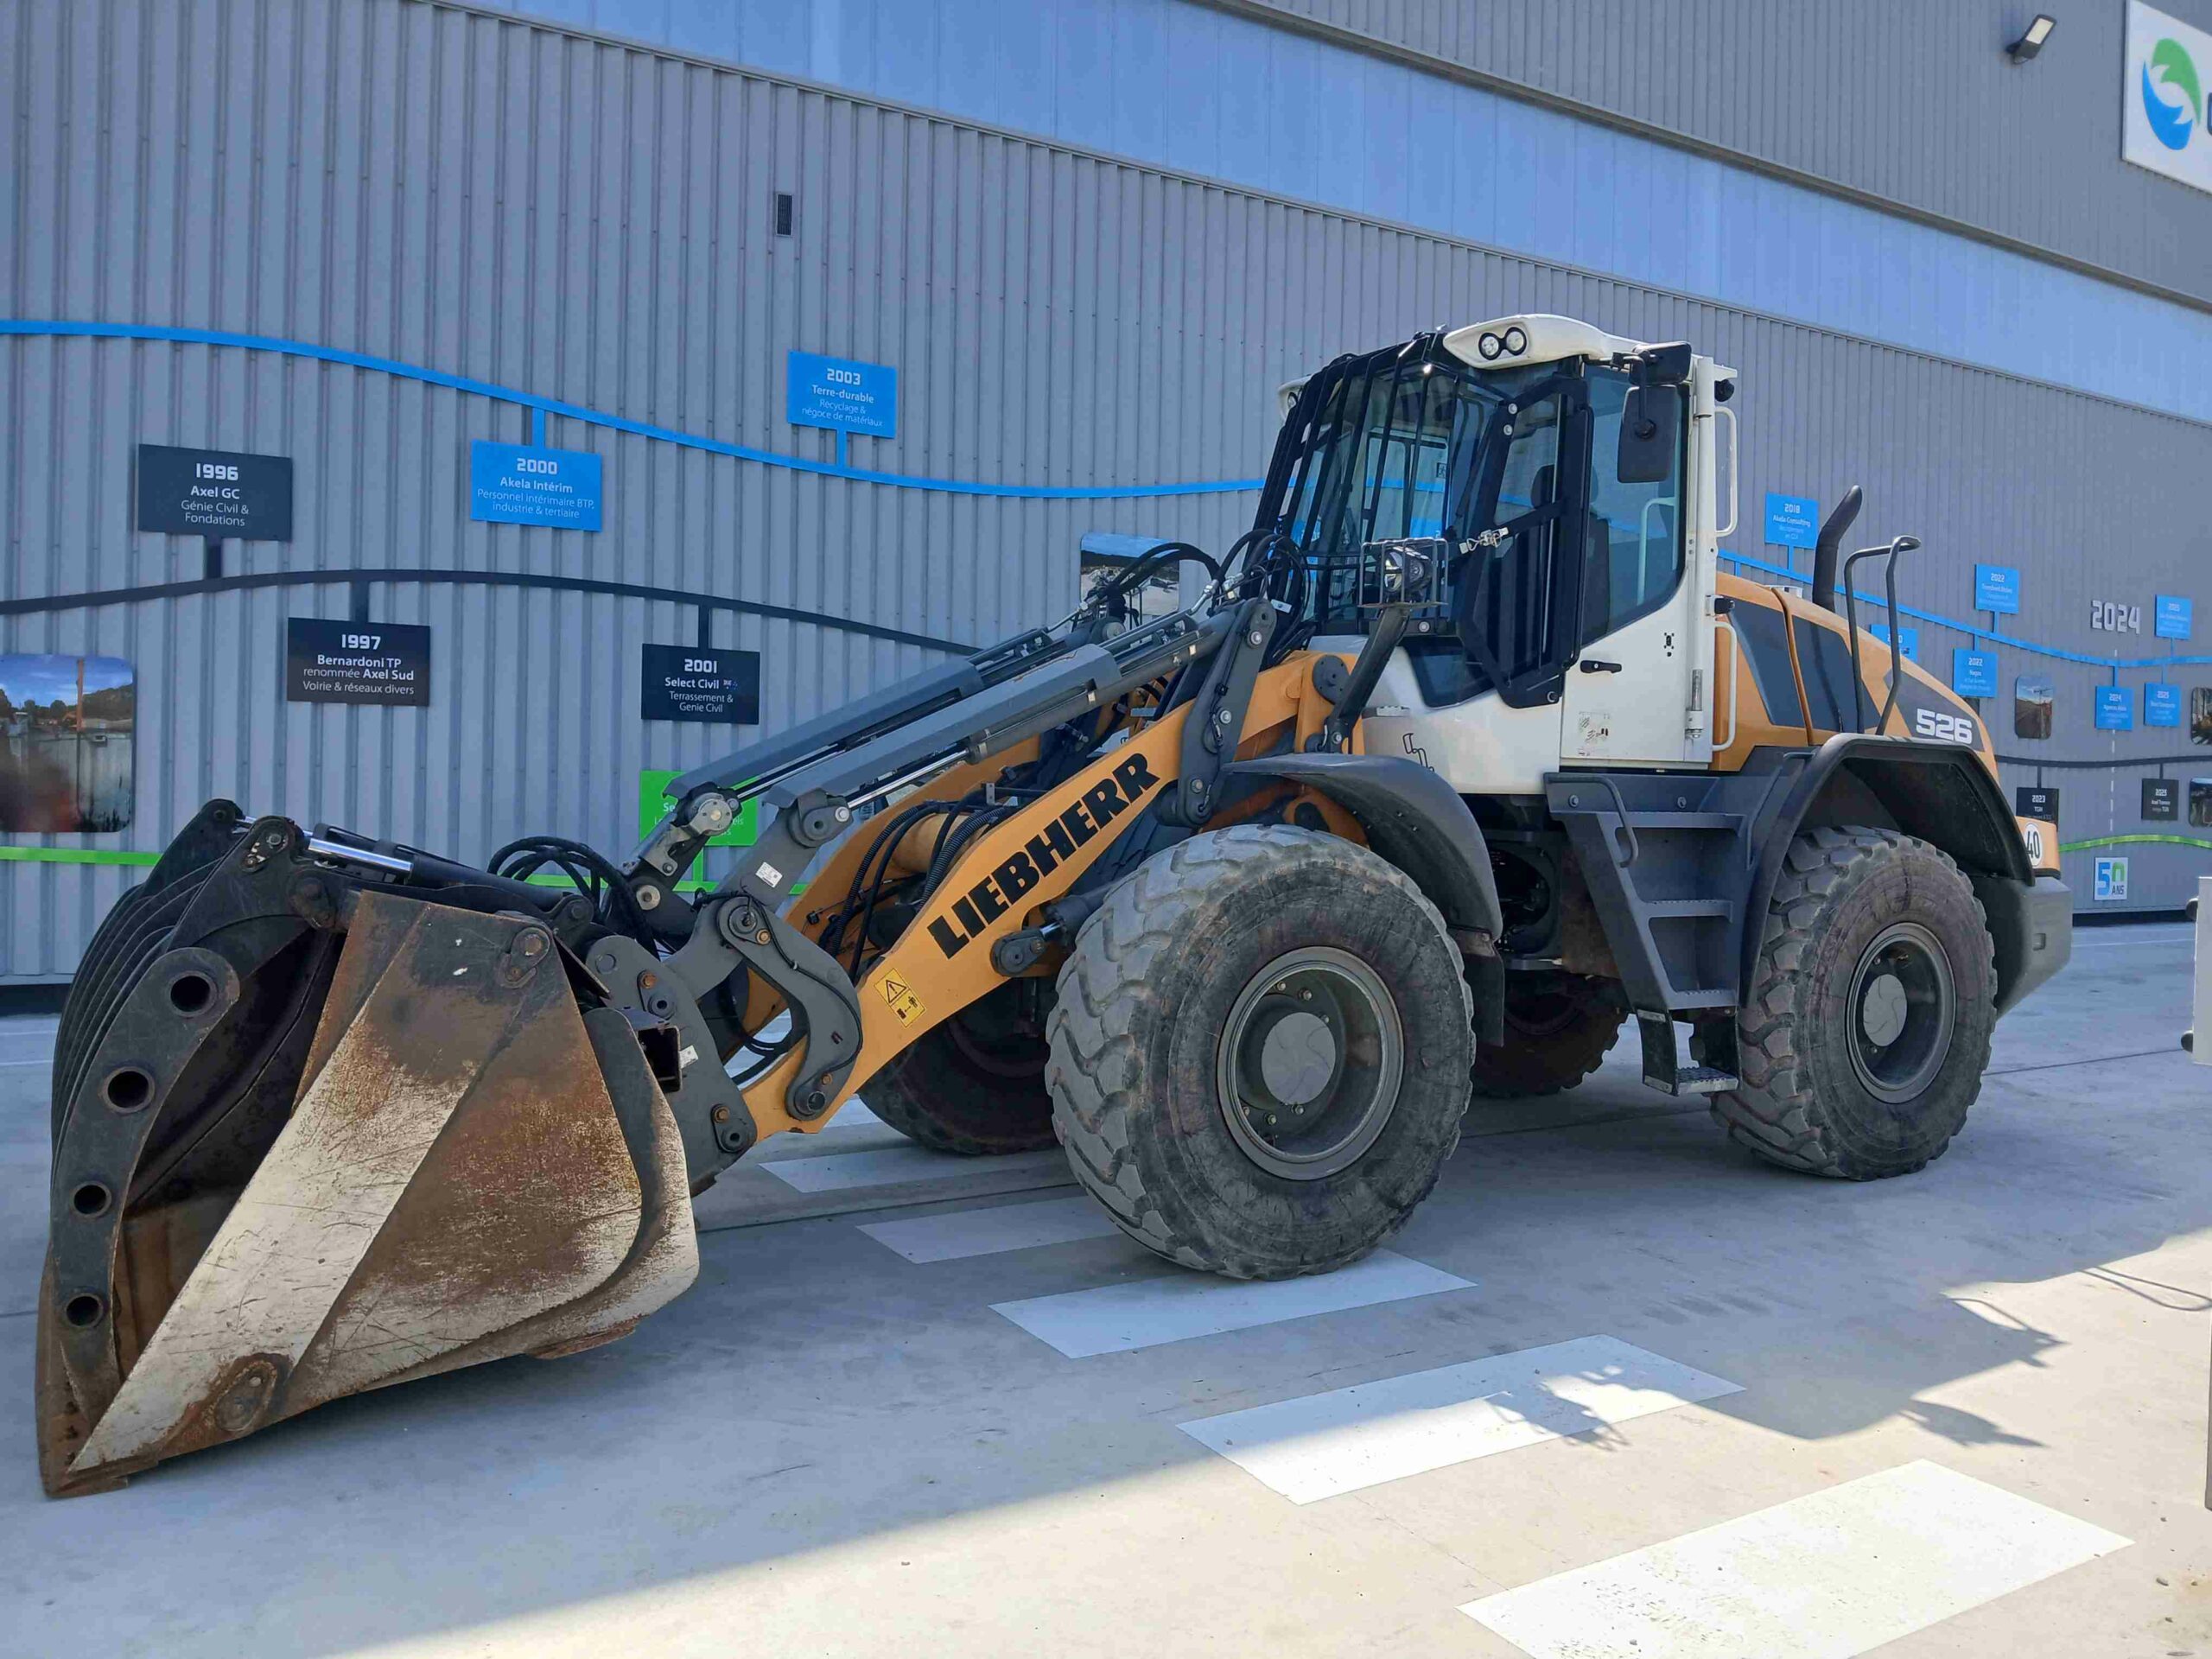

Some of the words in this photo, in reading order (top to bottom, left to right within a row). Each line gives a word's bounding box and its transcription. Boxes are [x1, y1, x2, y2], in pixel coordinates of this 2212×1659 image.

[827, 368, 861, 385] 2003
[812, 385, 874, 404] Terre-durable
[819, 399, 859, 414] Recyclage
[802, 407, 831, 419] négoce
[833, 412, 843, 421] de
[845, 415, 883, 427] matériaux
[195, 462, 238, 481] 1996
[516, 457, 557, 475] 2000
[190, 486, 218, 498] Axel
[221, 488, 240, 499] GC
[499, 476, 531, 490] Akela
[533, 480, 573, 493] Intérim
[477, 488, 524, 501] Personnel
[181, 499, 213, 512] Génie
[216, 502, 238, 514] Civil
[240, 505, 250, 515] &
[493, 501, 533, 514] industrie
[535, 506, 543, 515] &
[544, 507, 580, 518] tertiaire
[185, 512, 245, 527] Fondations
[2091, 599, 2141, 635] 2024
[341, 633, 381, 650] 1997
[317, 654, 385, 668] Bernardoni
[386, 658, 402, 669] TP
[683, 658, 717, 674] 2001
[303, 667, 361, 678] renommée
[362, 669, 389, 680] Axel
[391, 670, 414, 681] Sud
[302, 681, 332, 691] Voirie
[334, 682, 342, 691] &
[344, 682, 383, 693] réseaux
[385, 684, 415, 695] divers
[664, 677, 696, 688] Select
[697, 678, 720, 690] Civil
[669, 690, 725, 703] Terrassement
[727, 694, 734, 703] &
[705, 703, 723, 713] Civil
[1916, 708, 1973, 745] 526
[2026, 831, 2041, 859] 40
[926, 753, 1161, 960] LIEBHERR
[2112, 885, 2125, 895] ANS
